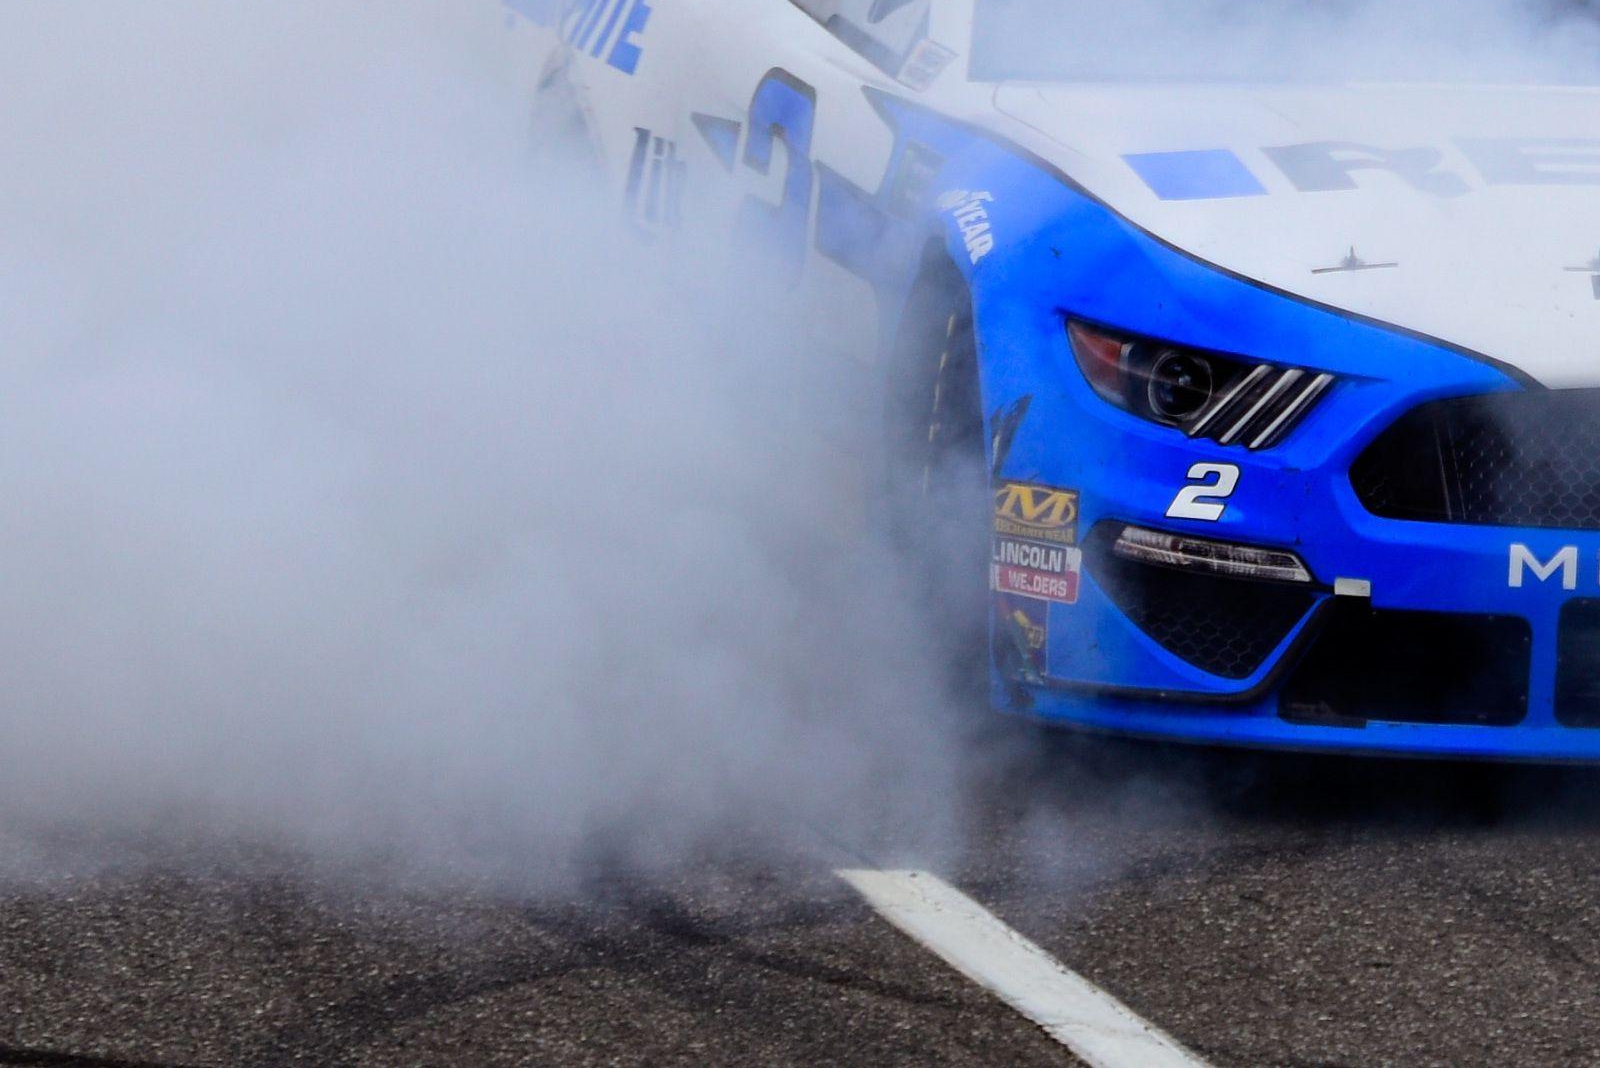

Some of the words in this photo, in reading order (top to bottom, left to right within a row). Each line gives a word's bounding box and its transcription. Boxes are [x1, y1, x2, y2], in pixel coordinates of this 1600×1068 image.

[1166, 463, 1239, 521] 2
[993, 540, 1062, 572] LINCOLN
[1008, 570, 1067, 597] WELDERS
